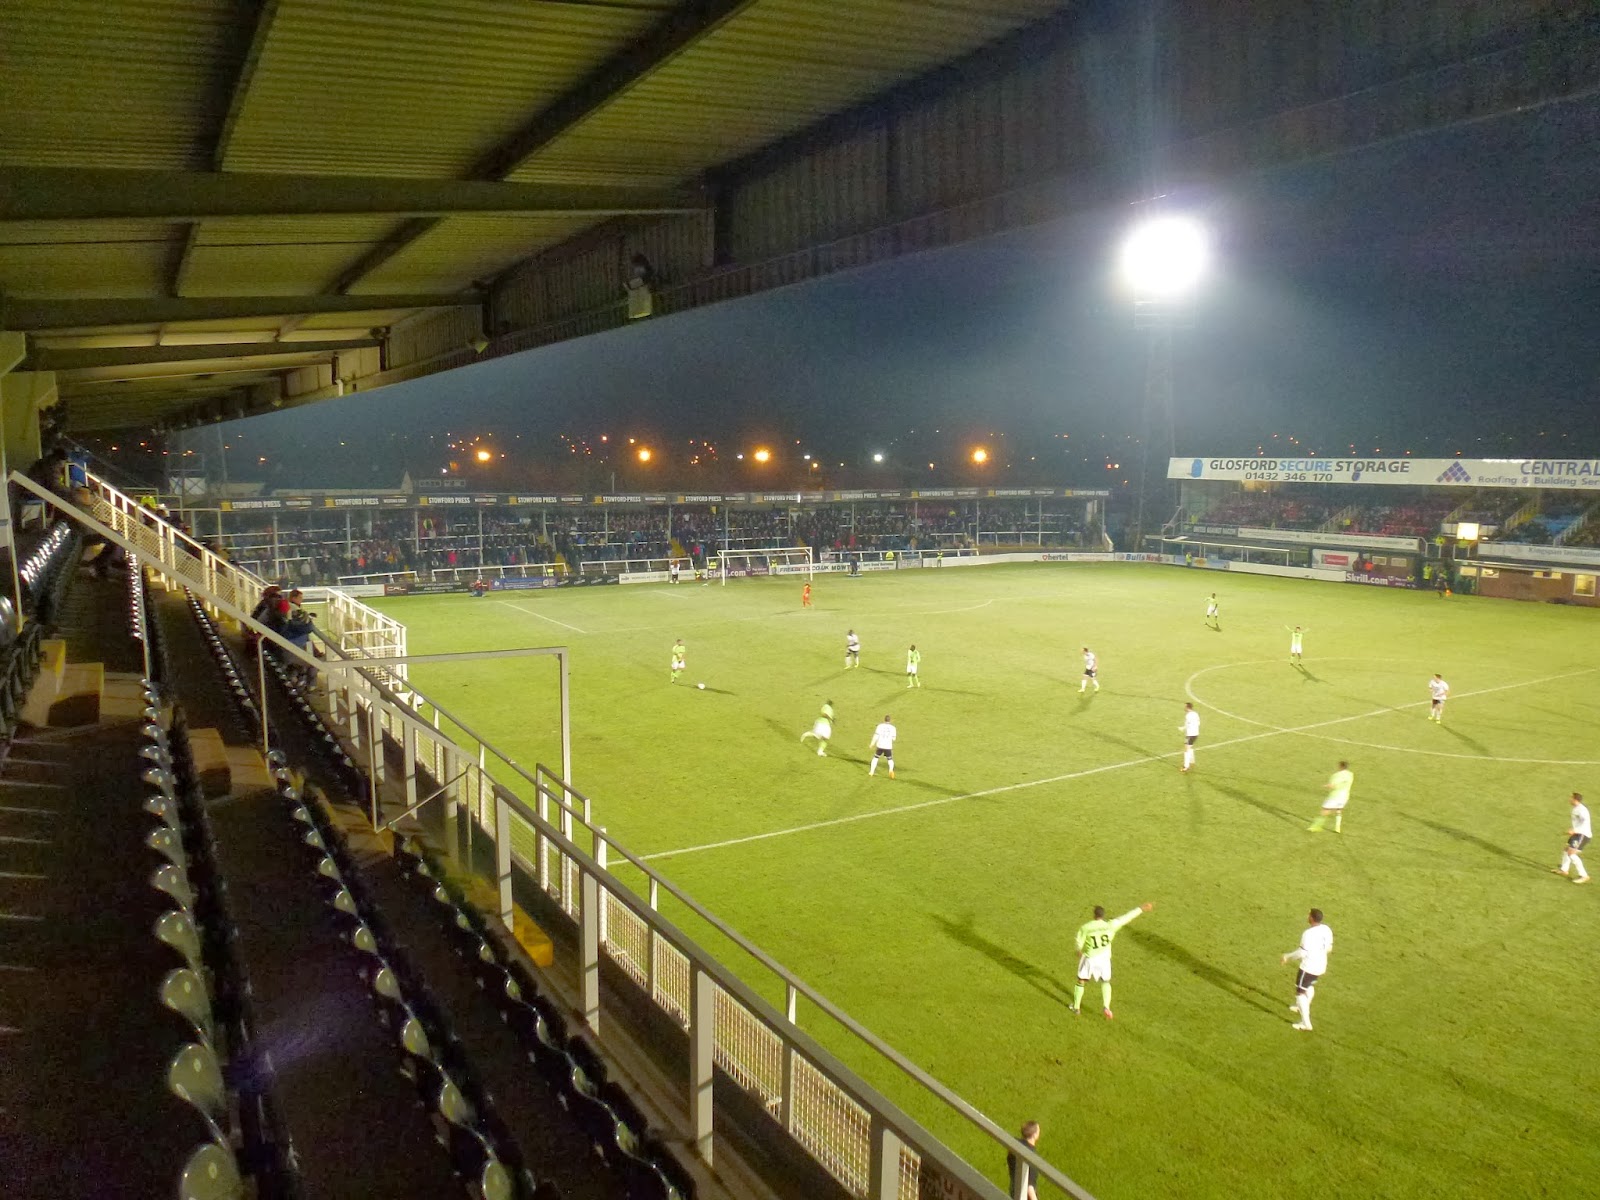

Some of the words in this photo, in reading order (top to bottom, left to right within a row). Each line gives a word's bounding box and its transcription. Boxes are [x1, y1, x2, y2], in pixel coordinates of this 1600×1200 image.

[1209, 460, 1277, 471] GLOSFORD
[1279, 460, 1333, 472] SECURE
[1334, 461, 1410, 473] STORAGE
[1520, 461, 1600, 476] CENTRAL
[1245, 472, 1278, 480] 01432
[1283, 473, 1306, 481] 346
[1313, 473, 1333, 482] 170
[1478, 475, 1517, 485] Roofing
[1522, 476, 1528, 484] &
[1534, 476, 1577, 486] Building
[455, 496, 470, 504] PRESS
[1047, 553, 1068, 561] hertel
[1125, 553, 1145, 561] Bulls
[708, 568, 746, 578] Skrl.com
[1346, 573, 1388, 585] Skrill.com
